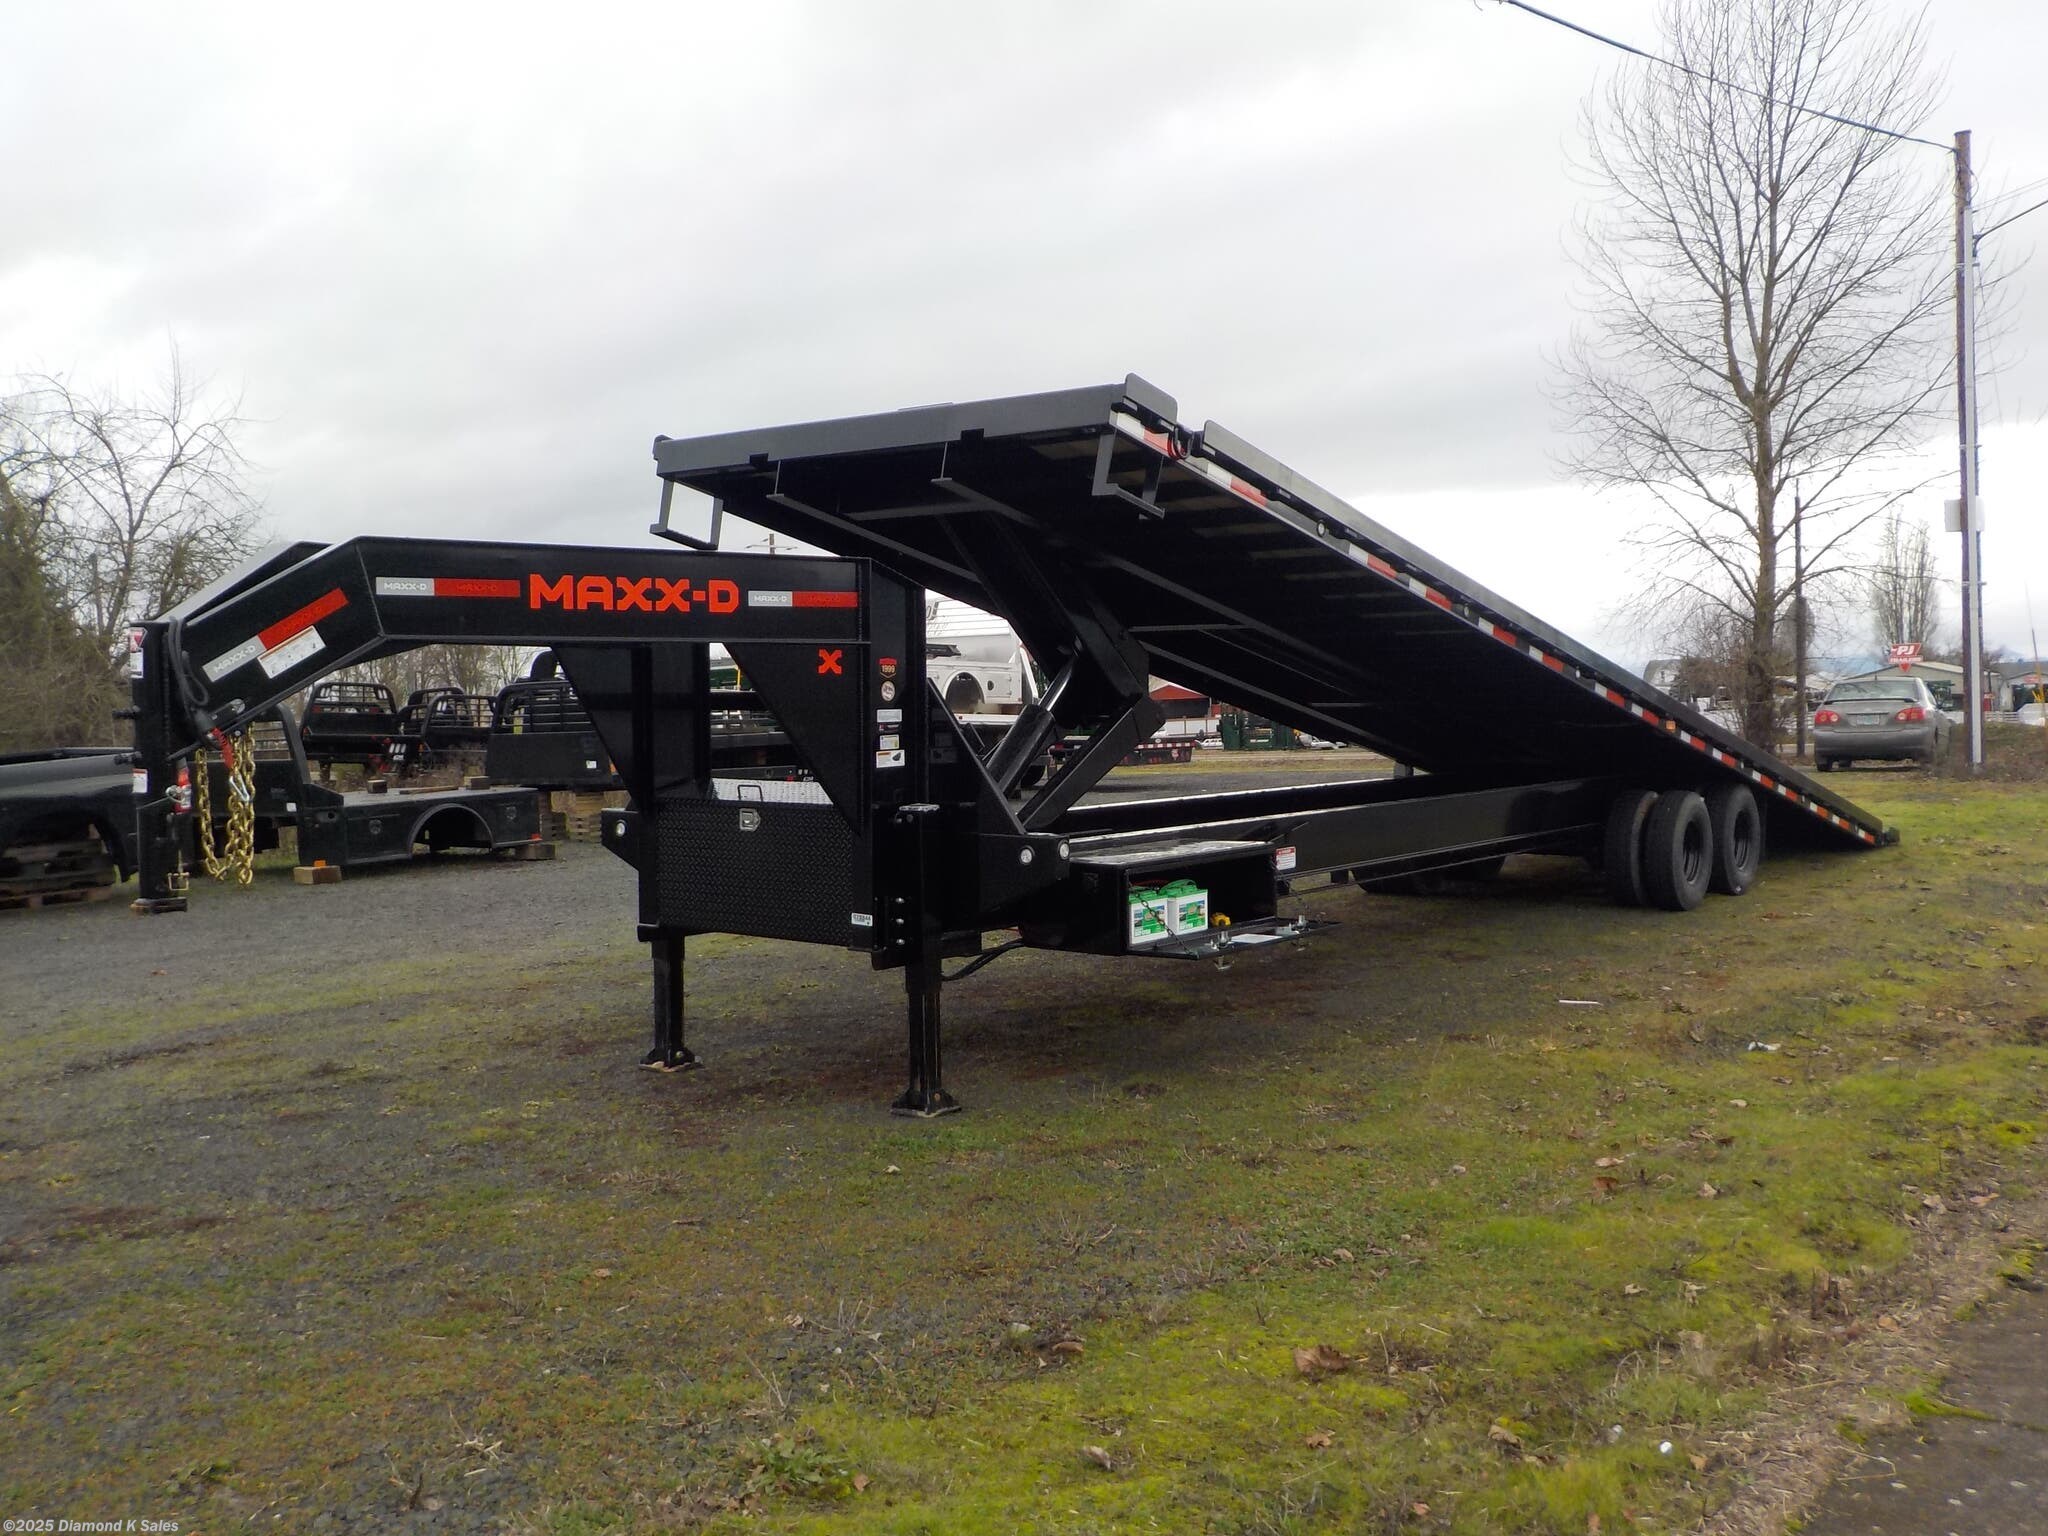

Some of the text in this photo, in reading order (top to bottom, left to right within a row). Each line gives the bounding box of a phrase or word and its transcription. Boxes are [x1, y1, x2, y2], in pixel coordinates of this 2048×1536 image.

[383, 582, 427, 591] MAXX-D
[529, 573, 740, 614] MAXX-D
[753, 594, 788, 603] MAXX-D
[213, 644, 257, 674] MAXX-D
[1896, 644, 1915, 656] PJ
[818, 648, 842, 674] X
